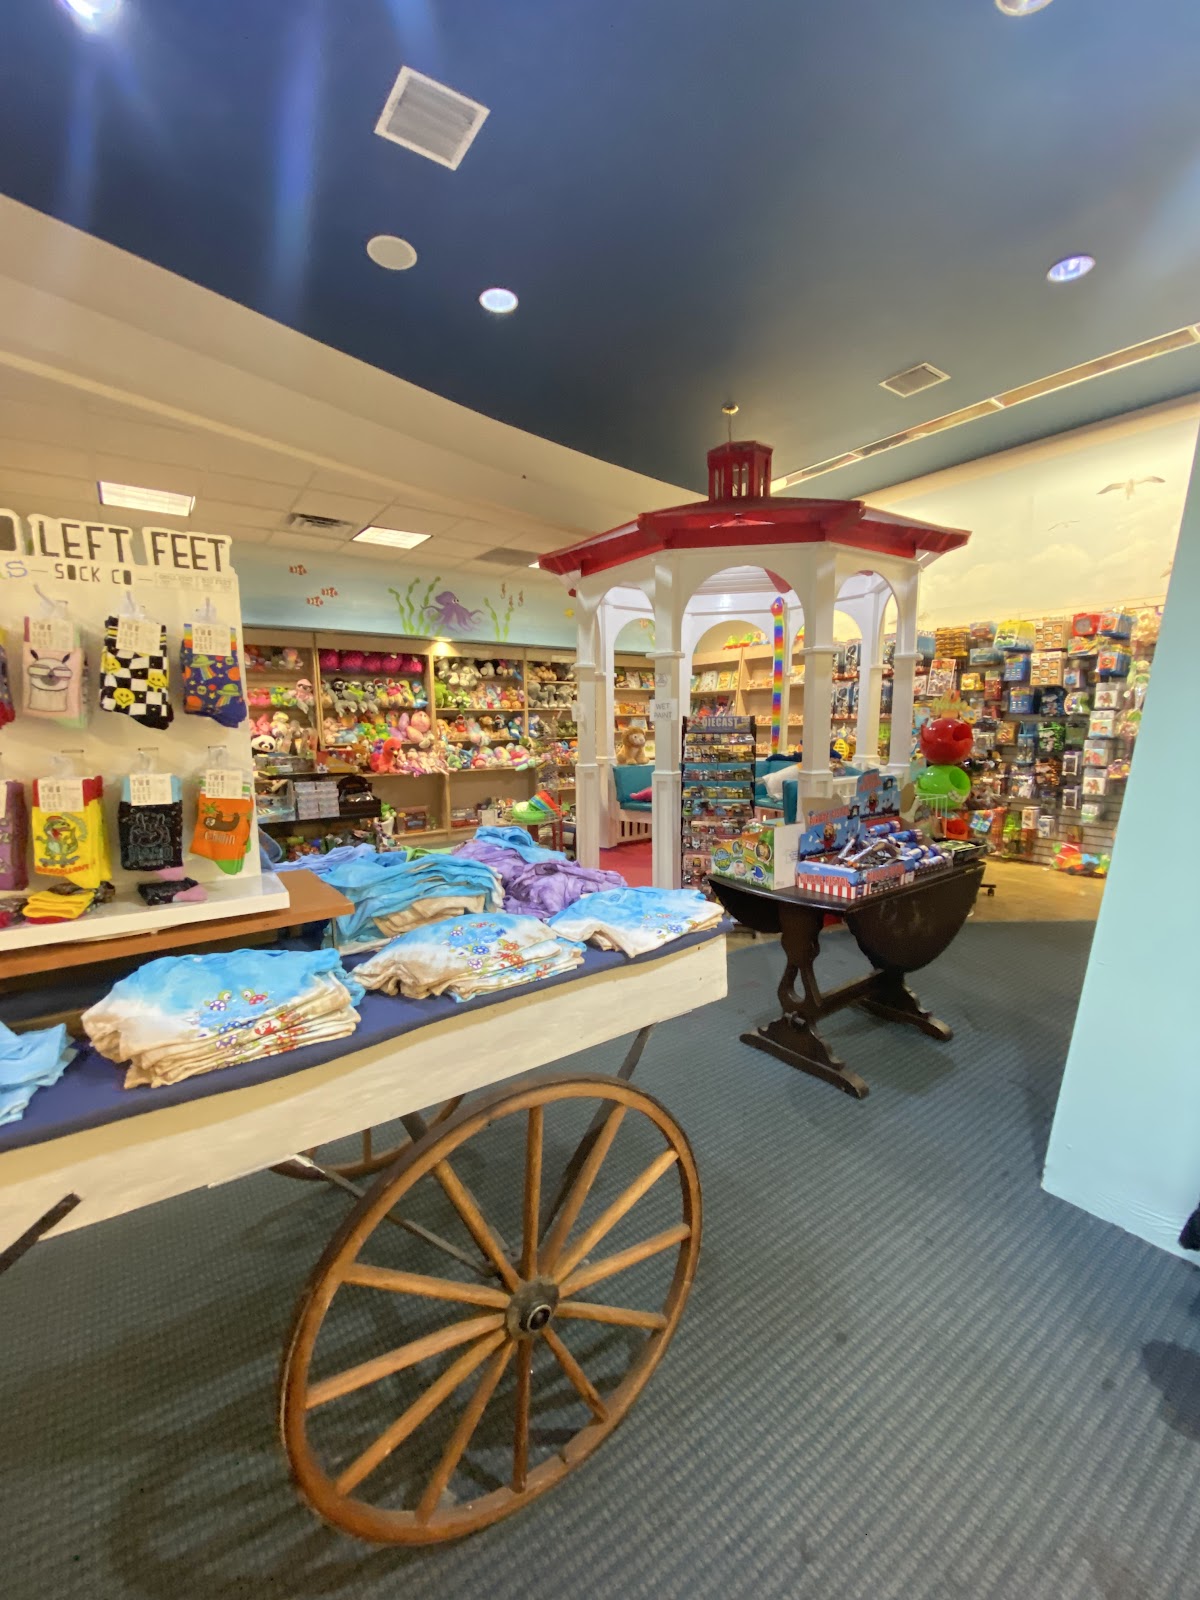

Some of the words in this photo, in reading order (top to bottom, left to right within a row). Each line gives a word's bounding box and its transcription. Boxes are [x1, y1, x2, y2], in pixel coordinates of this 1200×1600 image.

[39, 520, 129, 563] LEFT
[151, 531, 226, 572] FEET
[55, 563, 101, 582] SOCK
[111, 568, 132, 585] CO
[655, 702, 670, 710] WET
[653, 711, 673, 719] PAINT
[701, 716, 738, 728] DIECAST
